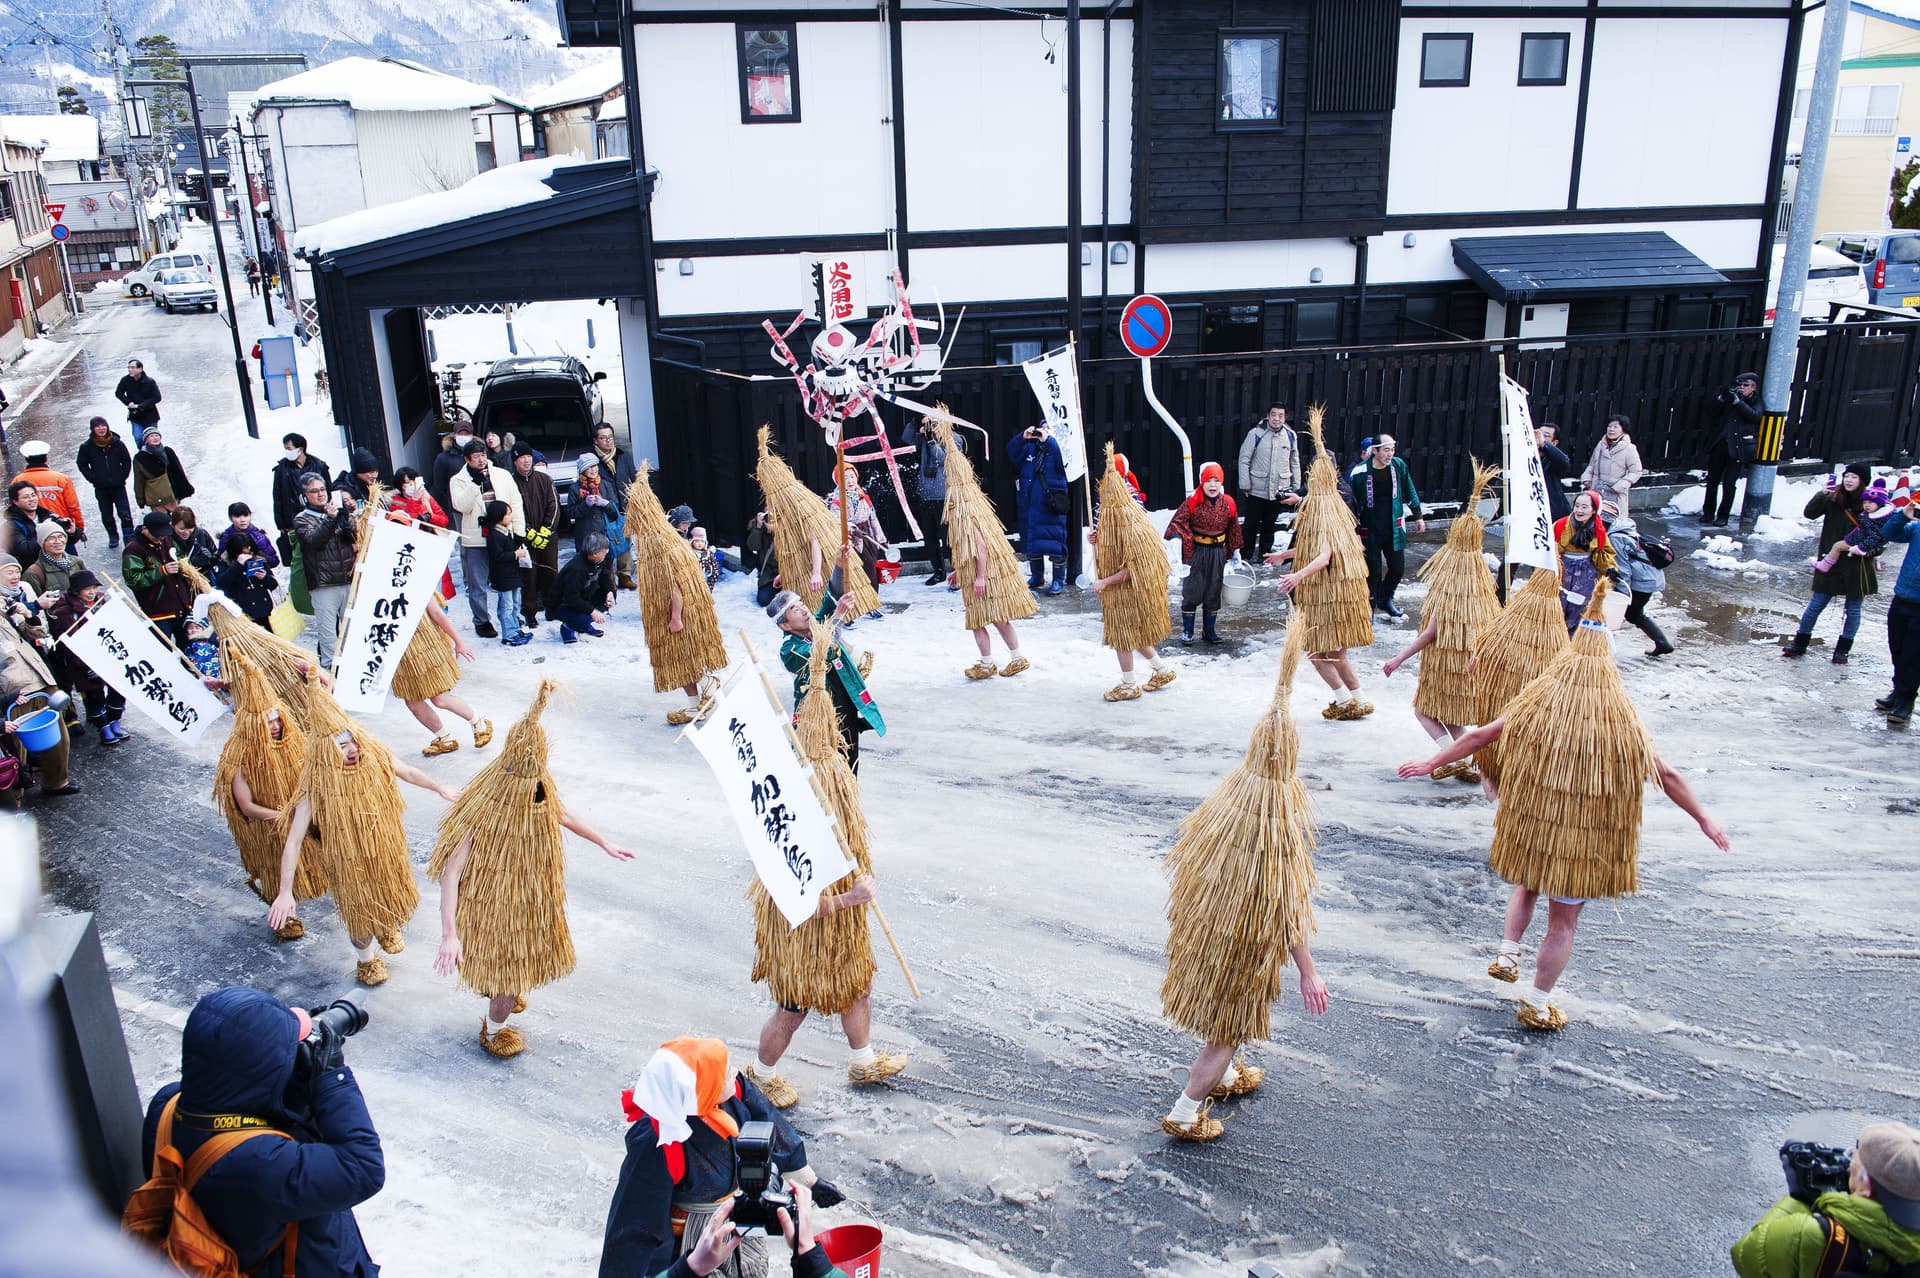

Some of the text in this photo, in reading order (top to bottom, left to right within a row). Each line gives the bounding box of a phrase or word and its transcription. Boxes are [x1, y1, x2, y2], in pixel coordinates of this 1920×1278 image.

[829, 261, 854, 320] 火の用心
[213, 1116, 241, 1129] D600
